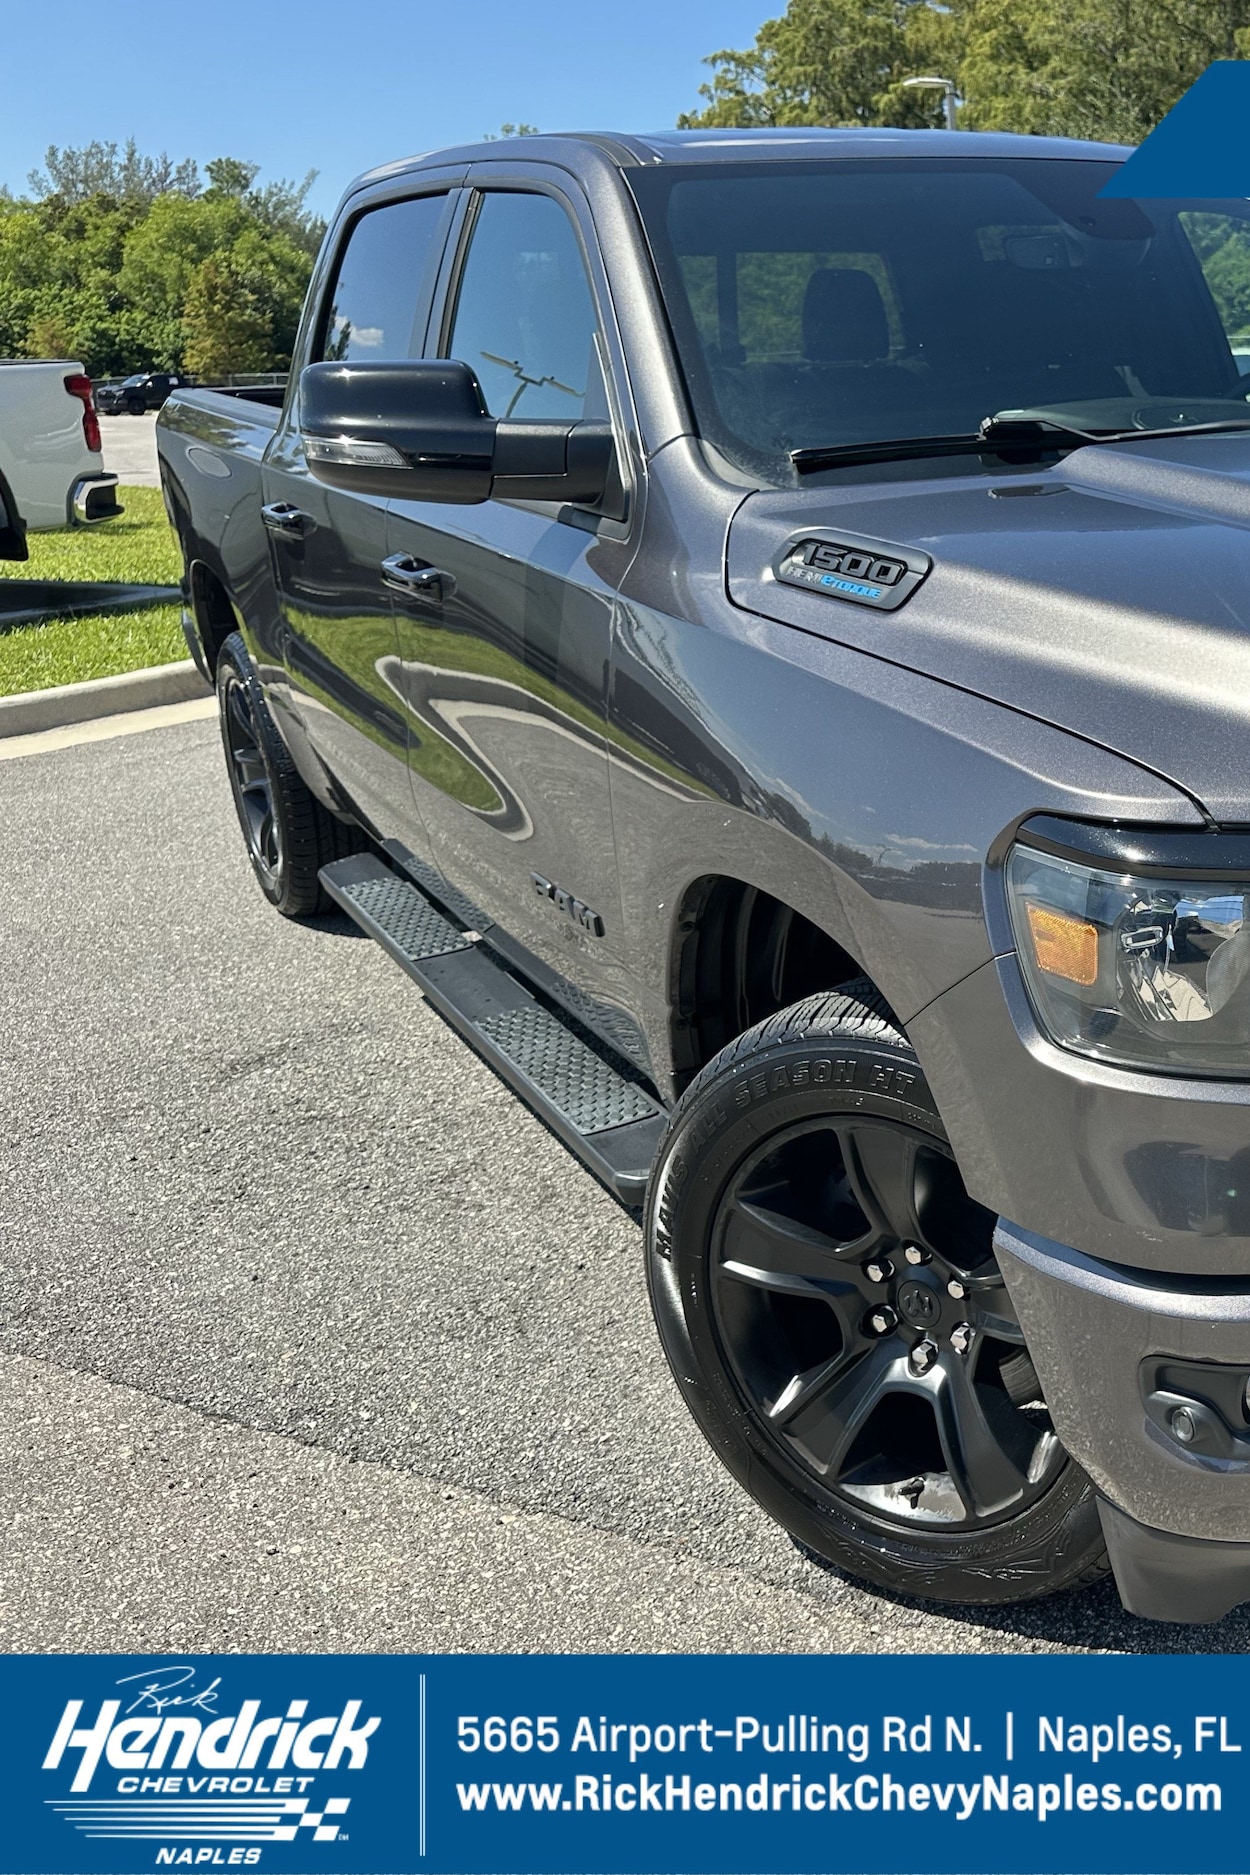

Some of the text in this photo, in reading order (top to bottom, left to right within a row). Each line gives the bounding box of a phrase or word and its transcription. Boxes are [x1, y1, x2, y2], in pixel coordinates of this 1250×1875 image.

[802, 543, 906, 586] 1500
[530, 871, 605, 937] RAM
[734, 1059, 857, 1108] SEASON
[870, 1064, 916, 1094] HT
